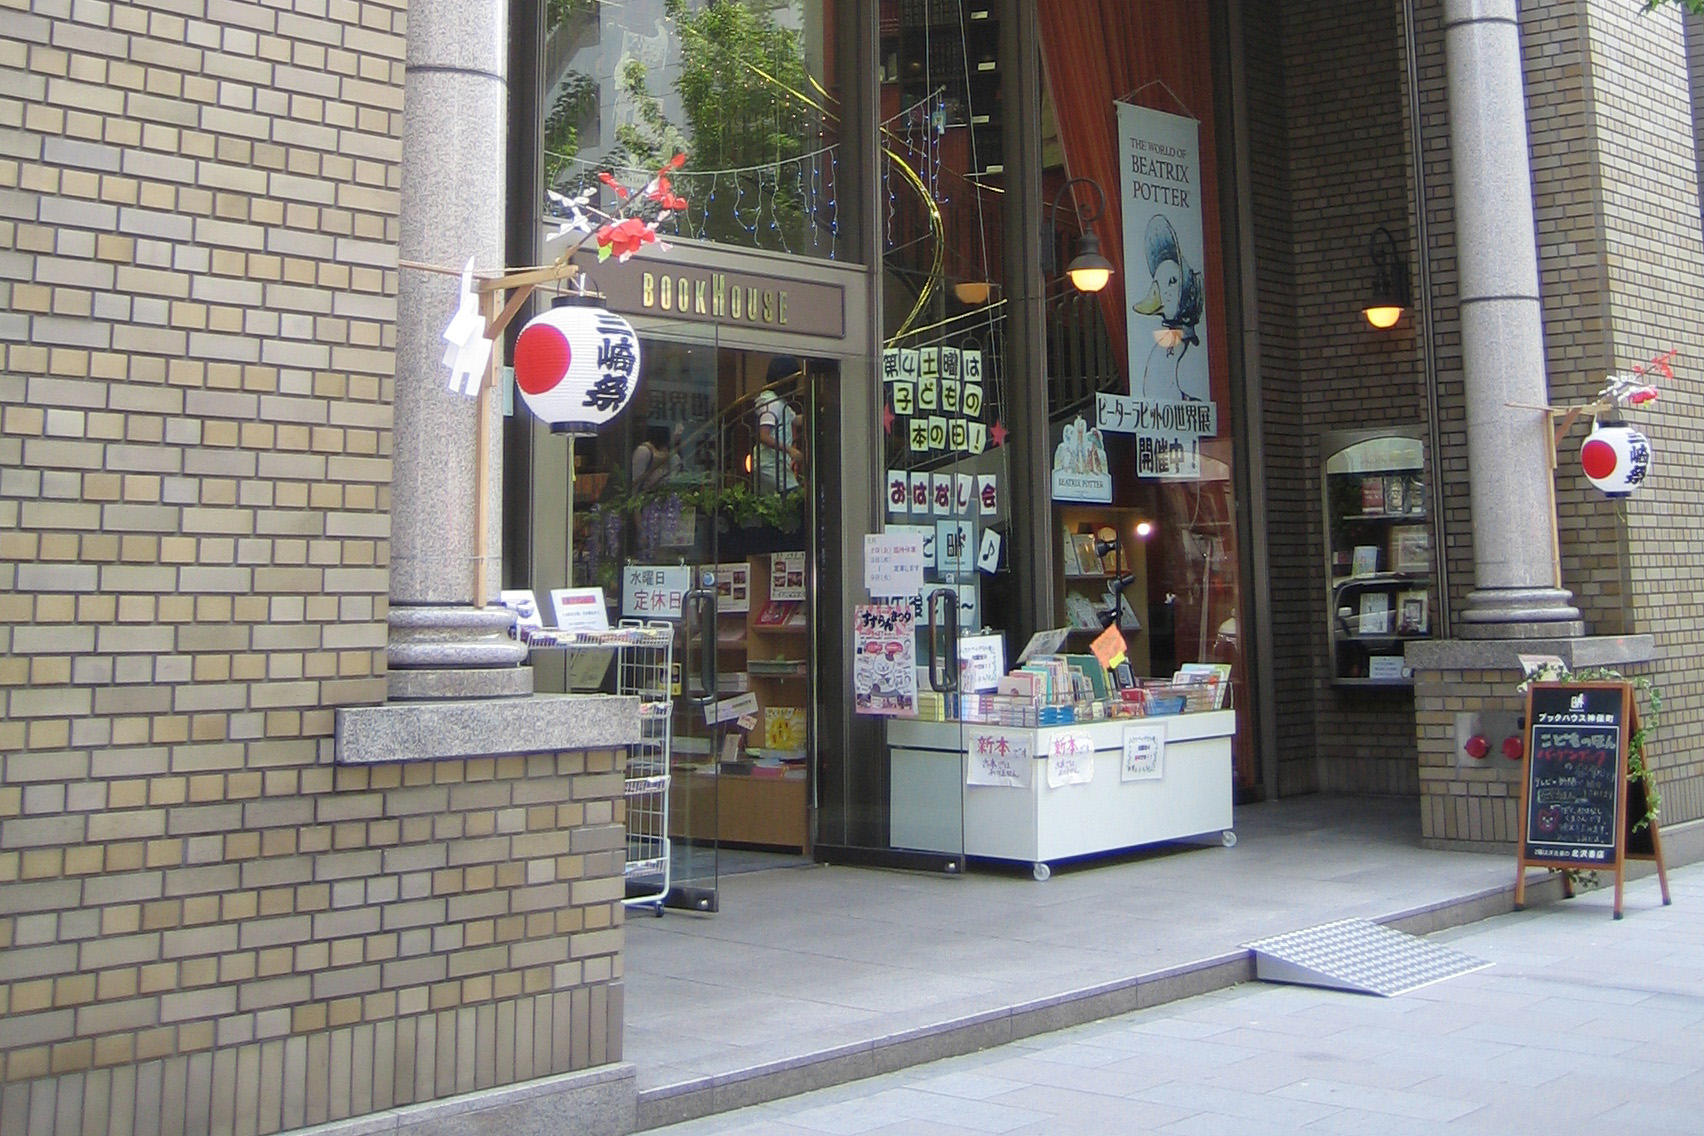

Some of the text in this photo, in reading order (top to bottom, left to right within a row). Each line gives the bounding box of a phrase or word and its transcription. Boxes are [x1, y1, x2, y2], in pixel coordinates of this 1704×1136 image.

[1130, 137, 1188, 159] THE WORLD OF
[1131, 154, 1189, 183] BEATRIX
[1132, 180, 1190, 208] POTTER
[896, 382, 980, 413] 子どもの
[1098, 397, 1211, 433] ピーターラビットの世界展
[890, 479, 997, 509] おはなし会
[630, 569, 665, 586] 水曜日
[633, 590, 681, 612] 定休日
